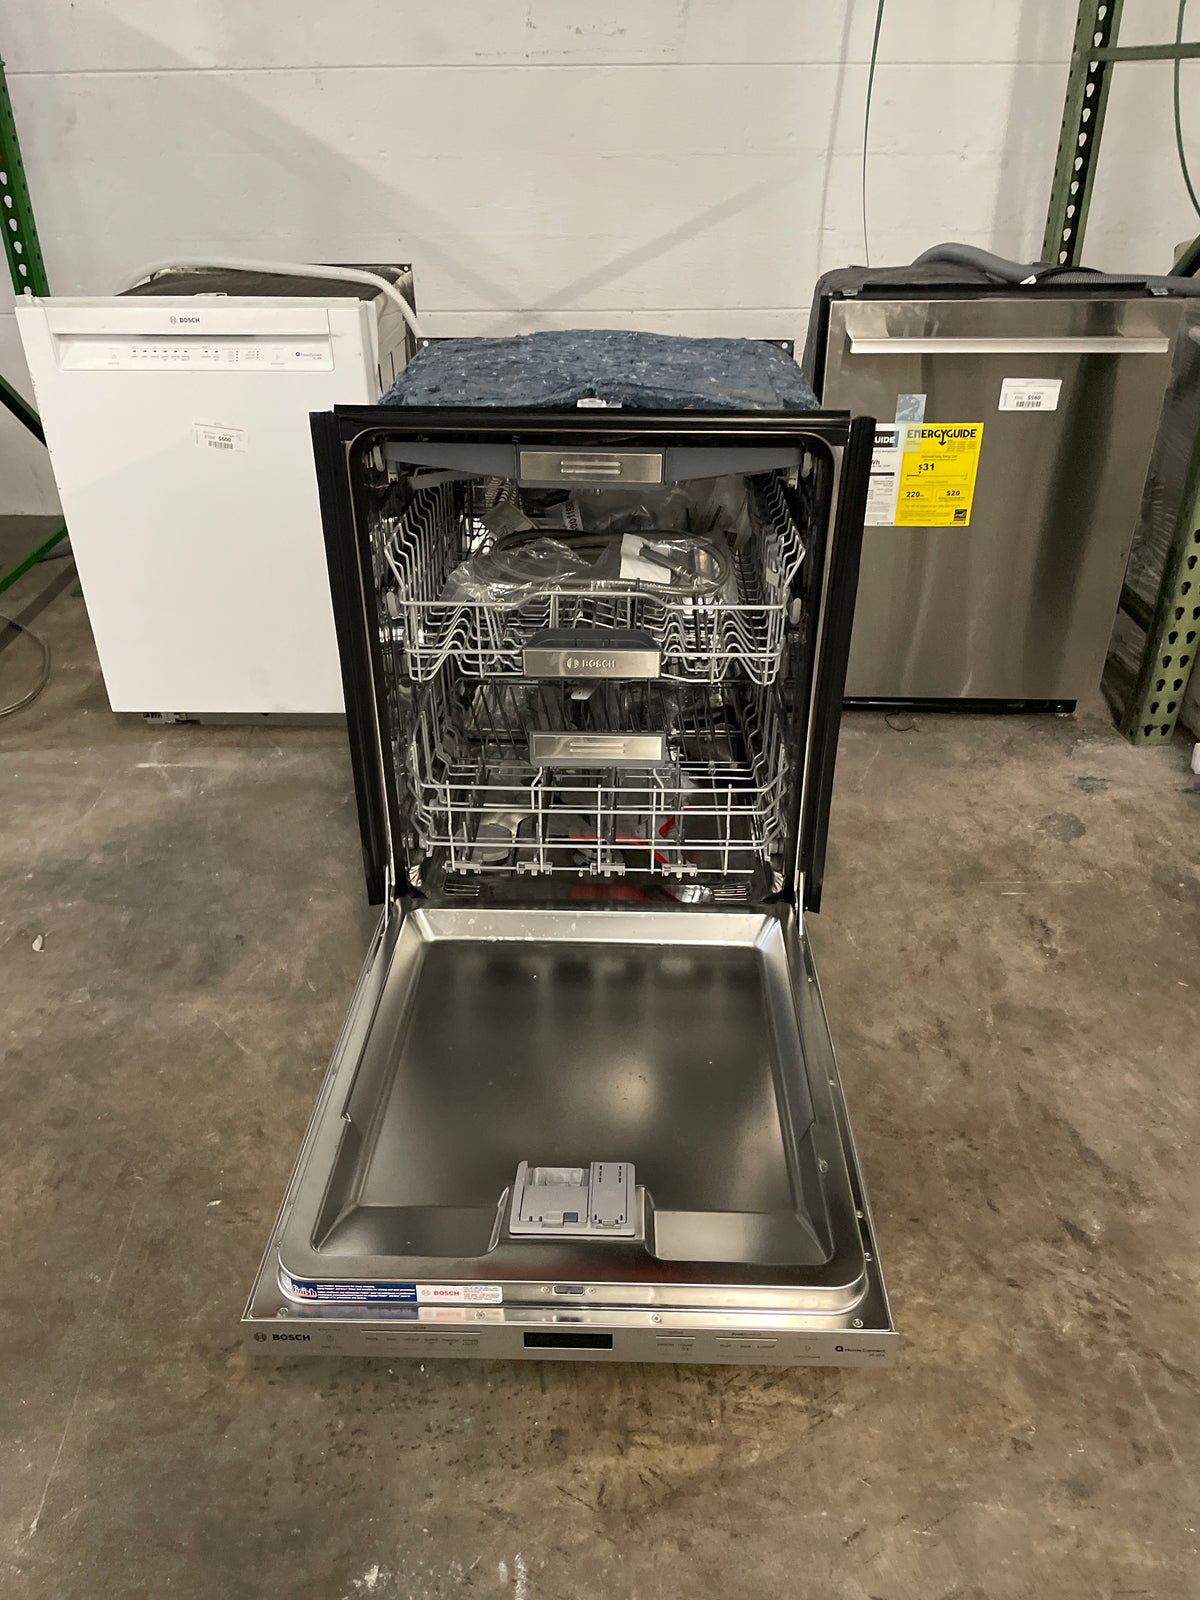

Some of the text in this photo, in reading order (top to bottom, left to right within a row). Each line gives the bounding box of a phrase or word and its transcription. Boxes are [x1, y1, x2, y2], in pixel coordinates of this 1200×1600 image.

[907, 429, 977, 441] ENERGYGUIDE
[873, 436, 896, 444] UIDE
[918, 463, 935, 471] $31
[582, 659, 616, 668] BOSCH
[272, 1333, 311, 1342] BOSCH
